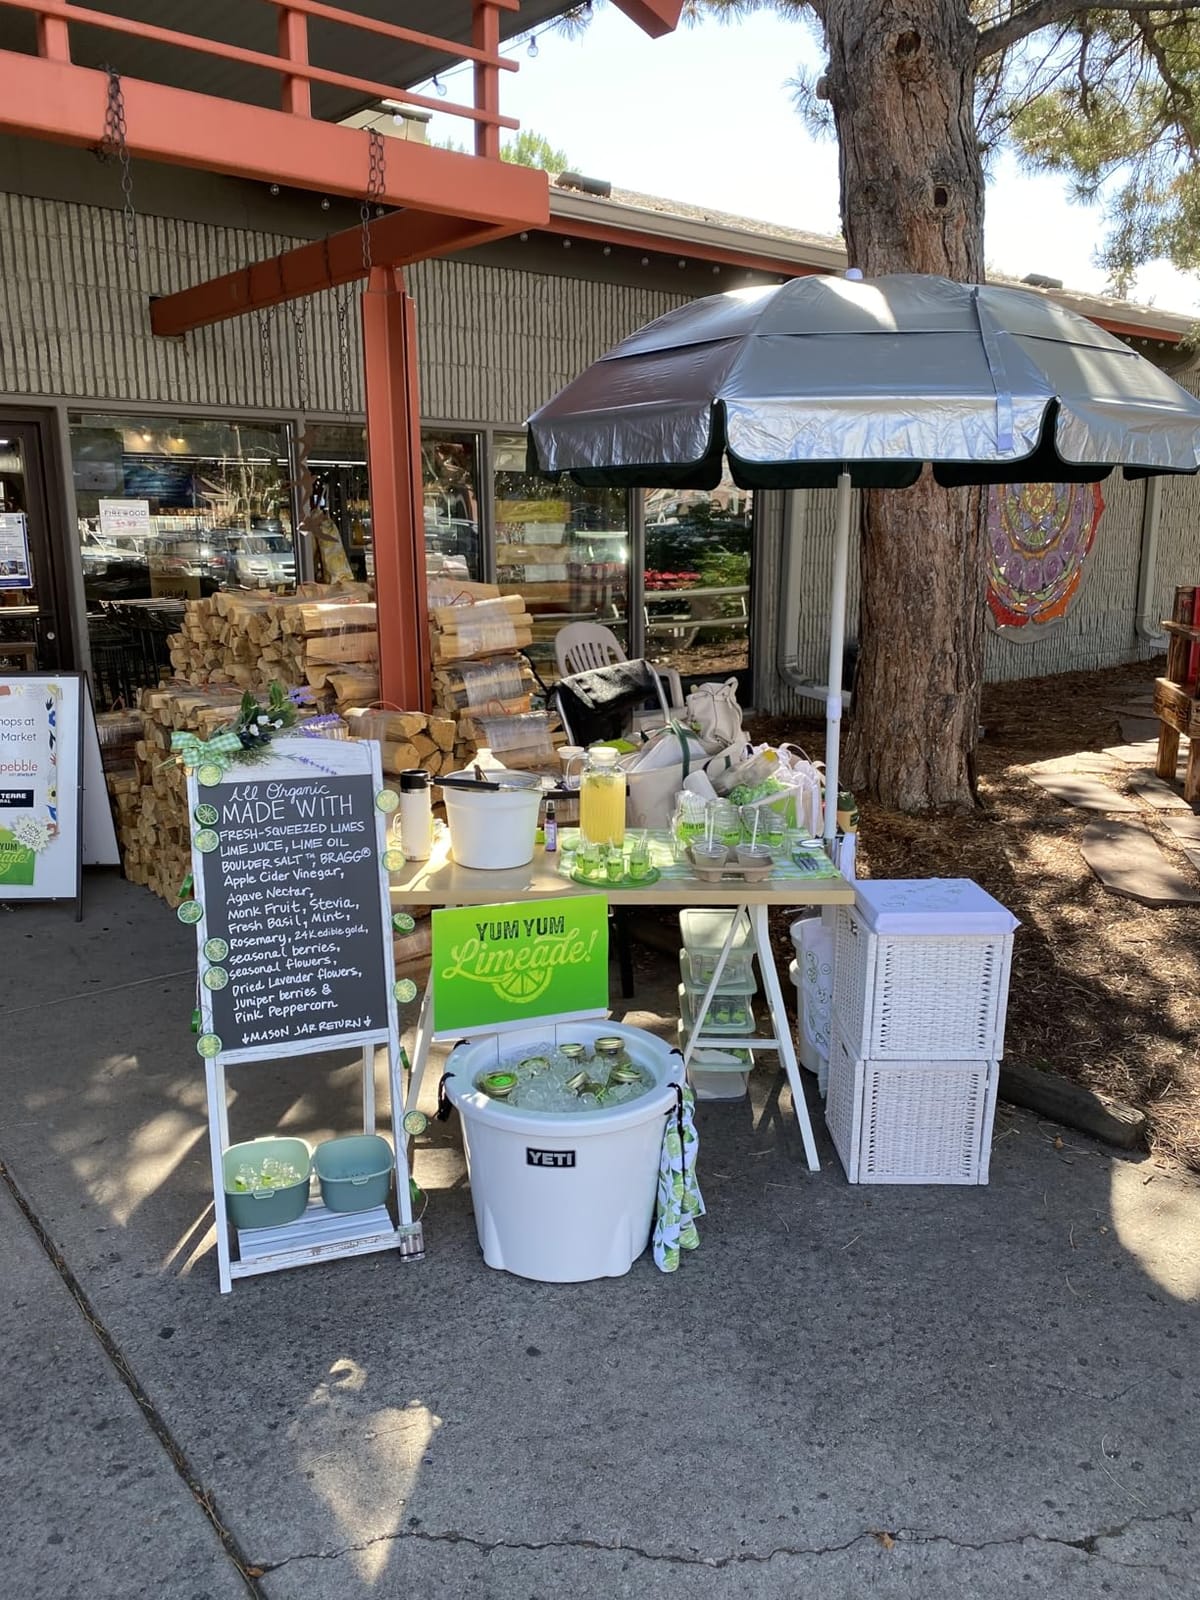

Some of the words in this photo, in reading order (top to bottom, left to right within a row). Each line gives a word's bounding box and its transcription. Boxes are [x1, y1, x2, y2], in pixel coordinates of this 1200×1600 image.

[24, 718, 34, 726] at
[1, 733, 37, 741] Market
[228, 785, 259, 802] All
[266, 782, 330, 804] Organic
[222, 800, 285, 824] MADE
[296, 794, 353, 818] WITH
[219, 822, 327, 842] FRESH-SQUEEZED
[330, 821, 365, 834] LIMES
[291, 838, 323, 850] LIME
[326, 838, 350, 848] OIL
[221, 859, 273, 873] BOULDER
[223, 873, 257, 889] Apple
[259, 871, 291, 882] Cider
[293, 867, 345, 880] Vinegar,
[226, 890, 263, 906] Agave
[266, 885, 314, 898] Nectar,
[227, 905, 262, 920] Monk
[309, 896, 360, 911] Stevia,
[228, 919, 263, 934] Fresh
[476, 922, 519, 942] YUM
[524, 915, 565, 937] YUM
[229, 934, 292, 950] Rosemary,
[229, 948, 286, 965] seasonal
[292, 942, 341, 955] berries,
[442, 928, 598, 984] Limeade!
[228, 962, 281, 980] seasonal
[285, 957, 338, 970] flowers,
[232, 981, 265, 997] Dried
[268, 973, 314, 988] Lavender
[316, 967, 363, 980] flowers,
[233, 995, 276, 1011] Juniper
[279, 988, 317, 1001] berries
[321, 984, 333, 996] &
[234, 1010, 264, 1024] Pink
[268, 1001, 339, 1017] Peppercorn
[250, 1025, 290, 1043] MASON
[294, 1025, 318, 1036] JAR
[318, 1019, 361, 1033] RETURN
[528, 1151, 573, 1166] YETI
